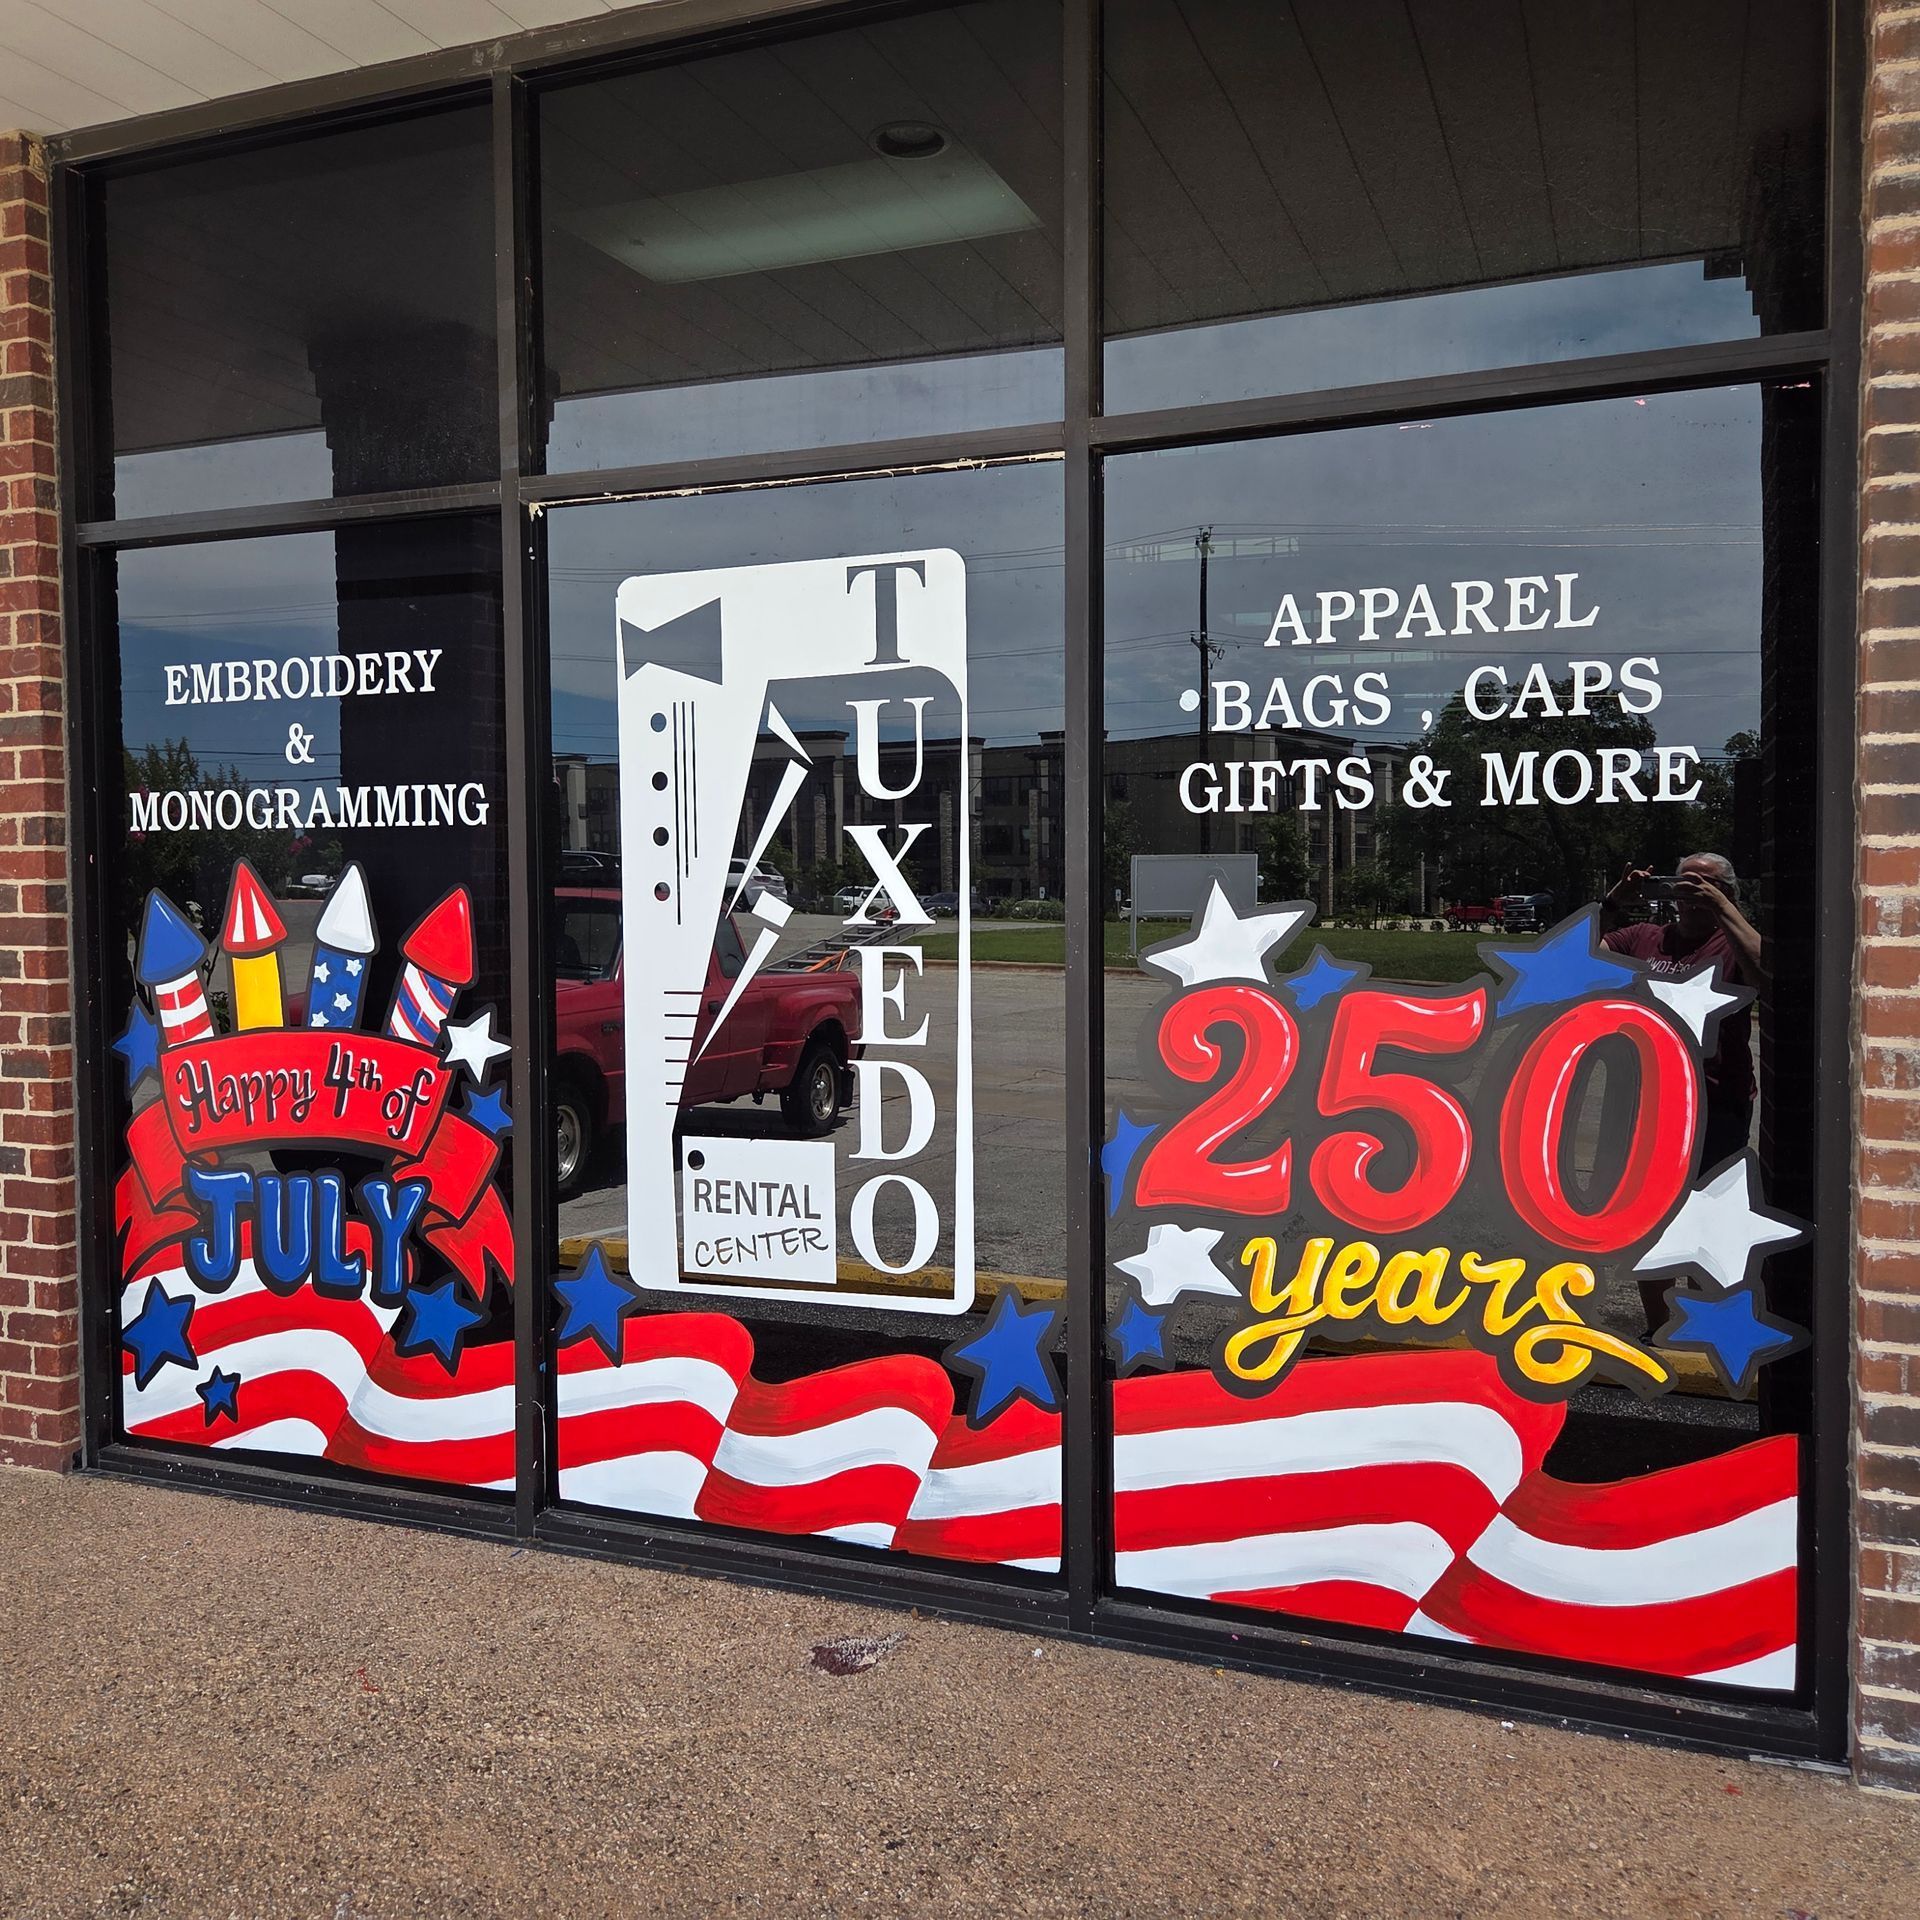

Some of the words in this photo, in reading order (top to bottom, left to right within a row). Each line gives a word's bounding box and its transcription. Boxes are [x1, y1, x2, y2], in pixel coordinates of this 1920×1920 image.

[1263, 572, 1601, 647] APPAREL
[163, 648, 443, 705] EMBROIDERY
[1464, 657, 1663, 721] CAPS
[285, 722, 315, 765] &
[129, 782, 490, 832] MONOGRAMMING
[1179, 756, 1374, 814] GIFTS
[1402, 755, 1452, 808] &
[1480, 745, 1703, 806] MORE
[842, 559, 941, 1275] TUXEDO
[176, 1059, 317, 1134] Happy
[323, 1042, 383, 1119] 4th
[381, 1067, 436, 1142] of
[1136, 987, 1699, 1252] 250
[186, 1167, 428, 1296] JULY
[693, 1178, 822, 1220] RENTAL
[694, 1227, 829, 1268] CENTER
[1224, 1236, 1669, 1385] years
